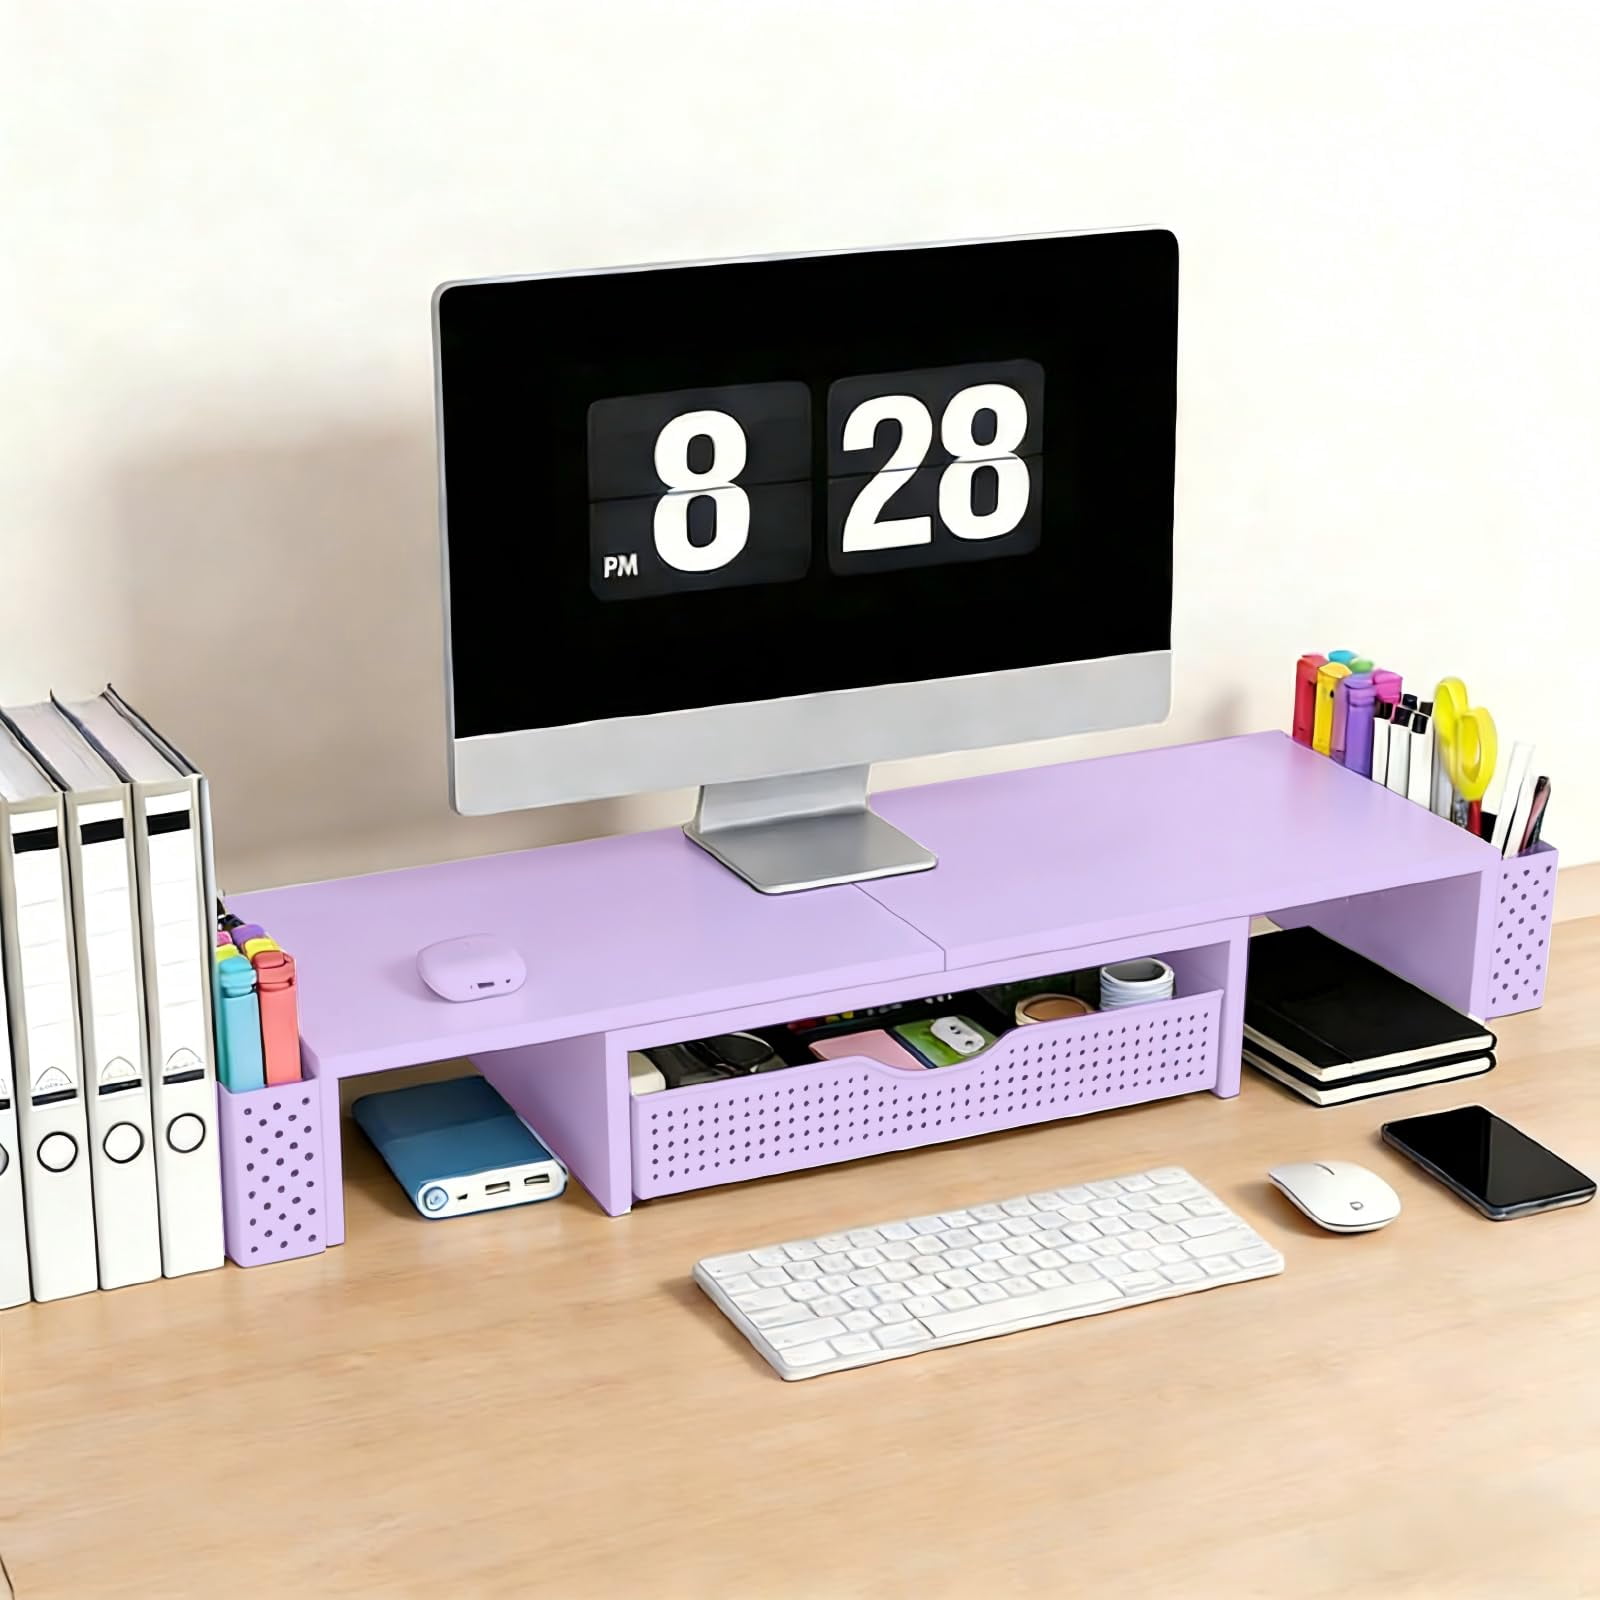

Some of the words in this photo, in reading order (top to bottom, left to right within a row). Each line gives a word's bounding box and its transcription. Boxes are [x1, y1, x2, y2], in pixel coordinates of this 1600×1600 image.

[653, 410, 750, 572] 8
[842, 383, 1030, 553] 28
[603, 553, 639, 578] PM
